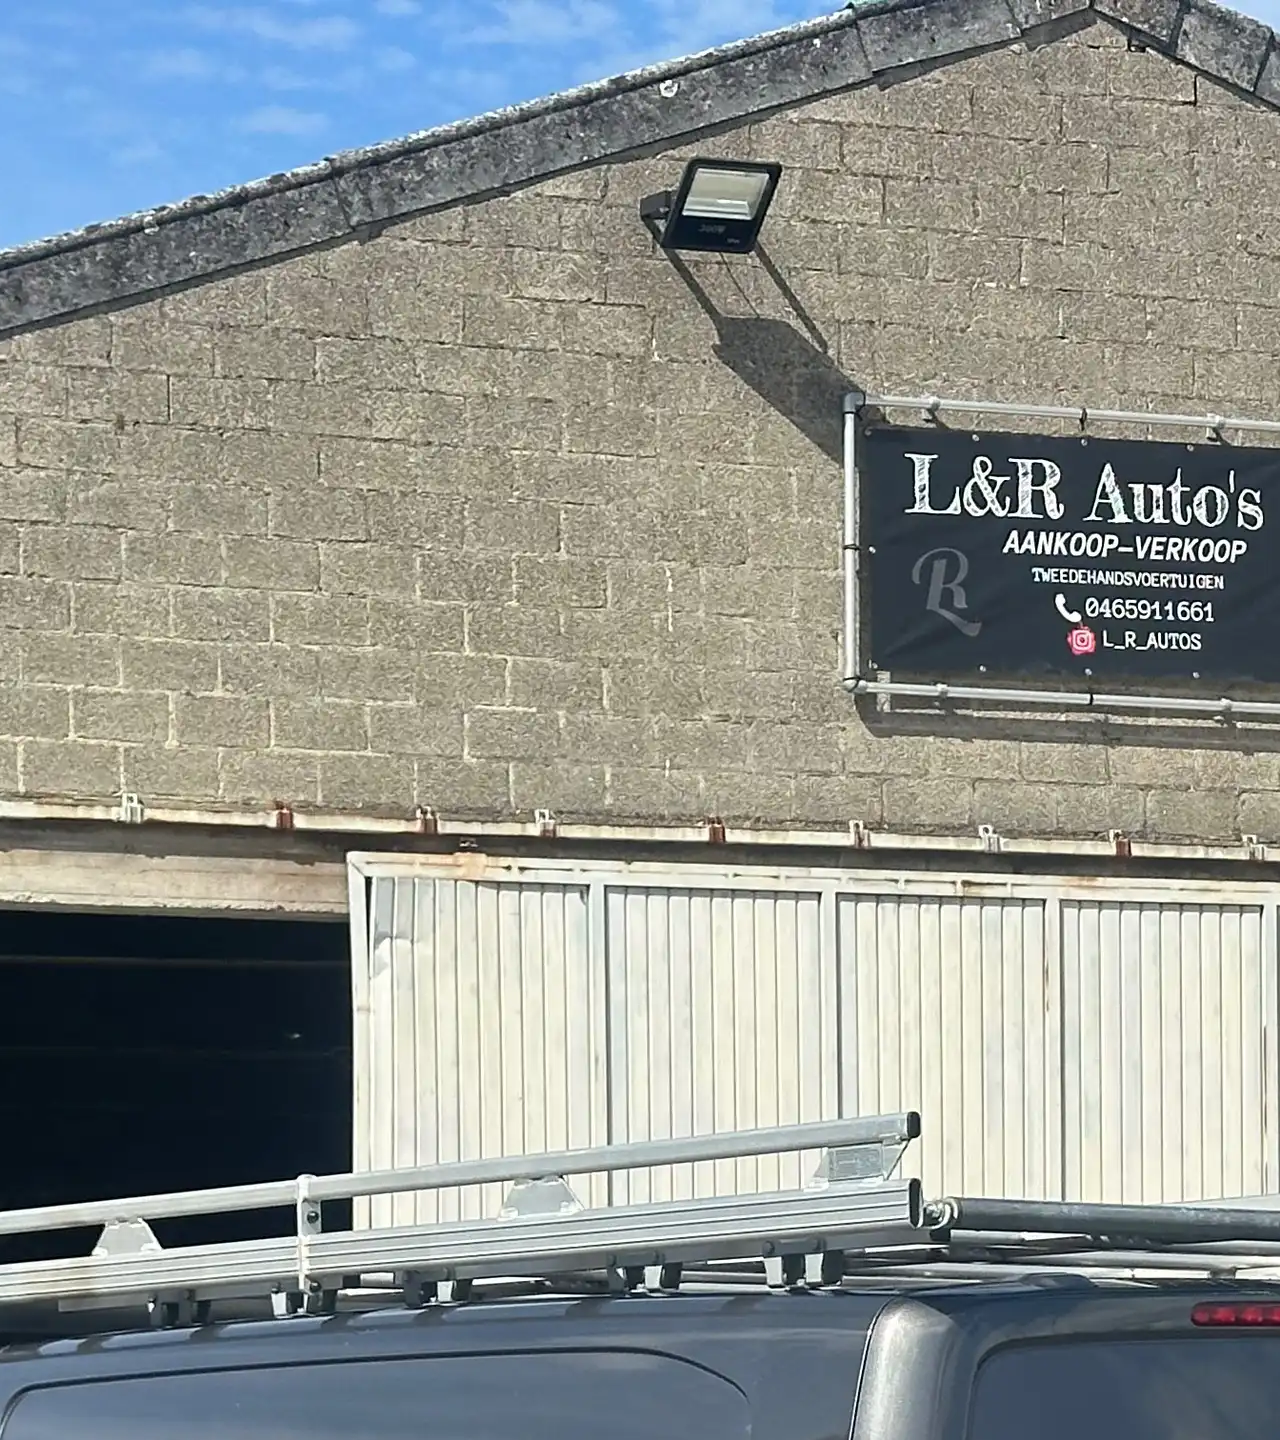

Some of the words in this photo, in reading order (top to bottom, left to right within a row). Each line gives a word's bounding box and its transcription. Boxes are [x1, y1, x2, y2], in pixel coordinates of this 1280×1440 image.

[904, 453, 1065, 520] L&R
[1083, 462, 1264, 531] Auto's
[1003, 529, 1247, 563] AANKOOP-VERKOOP
[1031, 567, 1225, 589] TWEEDEHANDSVOERTUIGEN
[1085, 597, 1215, 622] 0465911661
[1102, 630, 1202, 650] L_R_AUTOS
